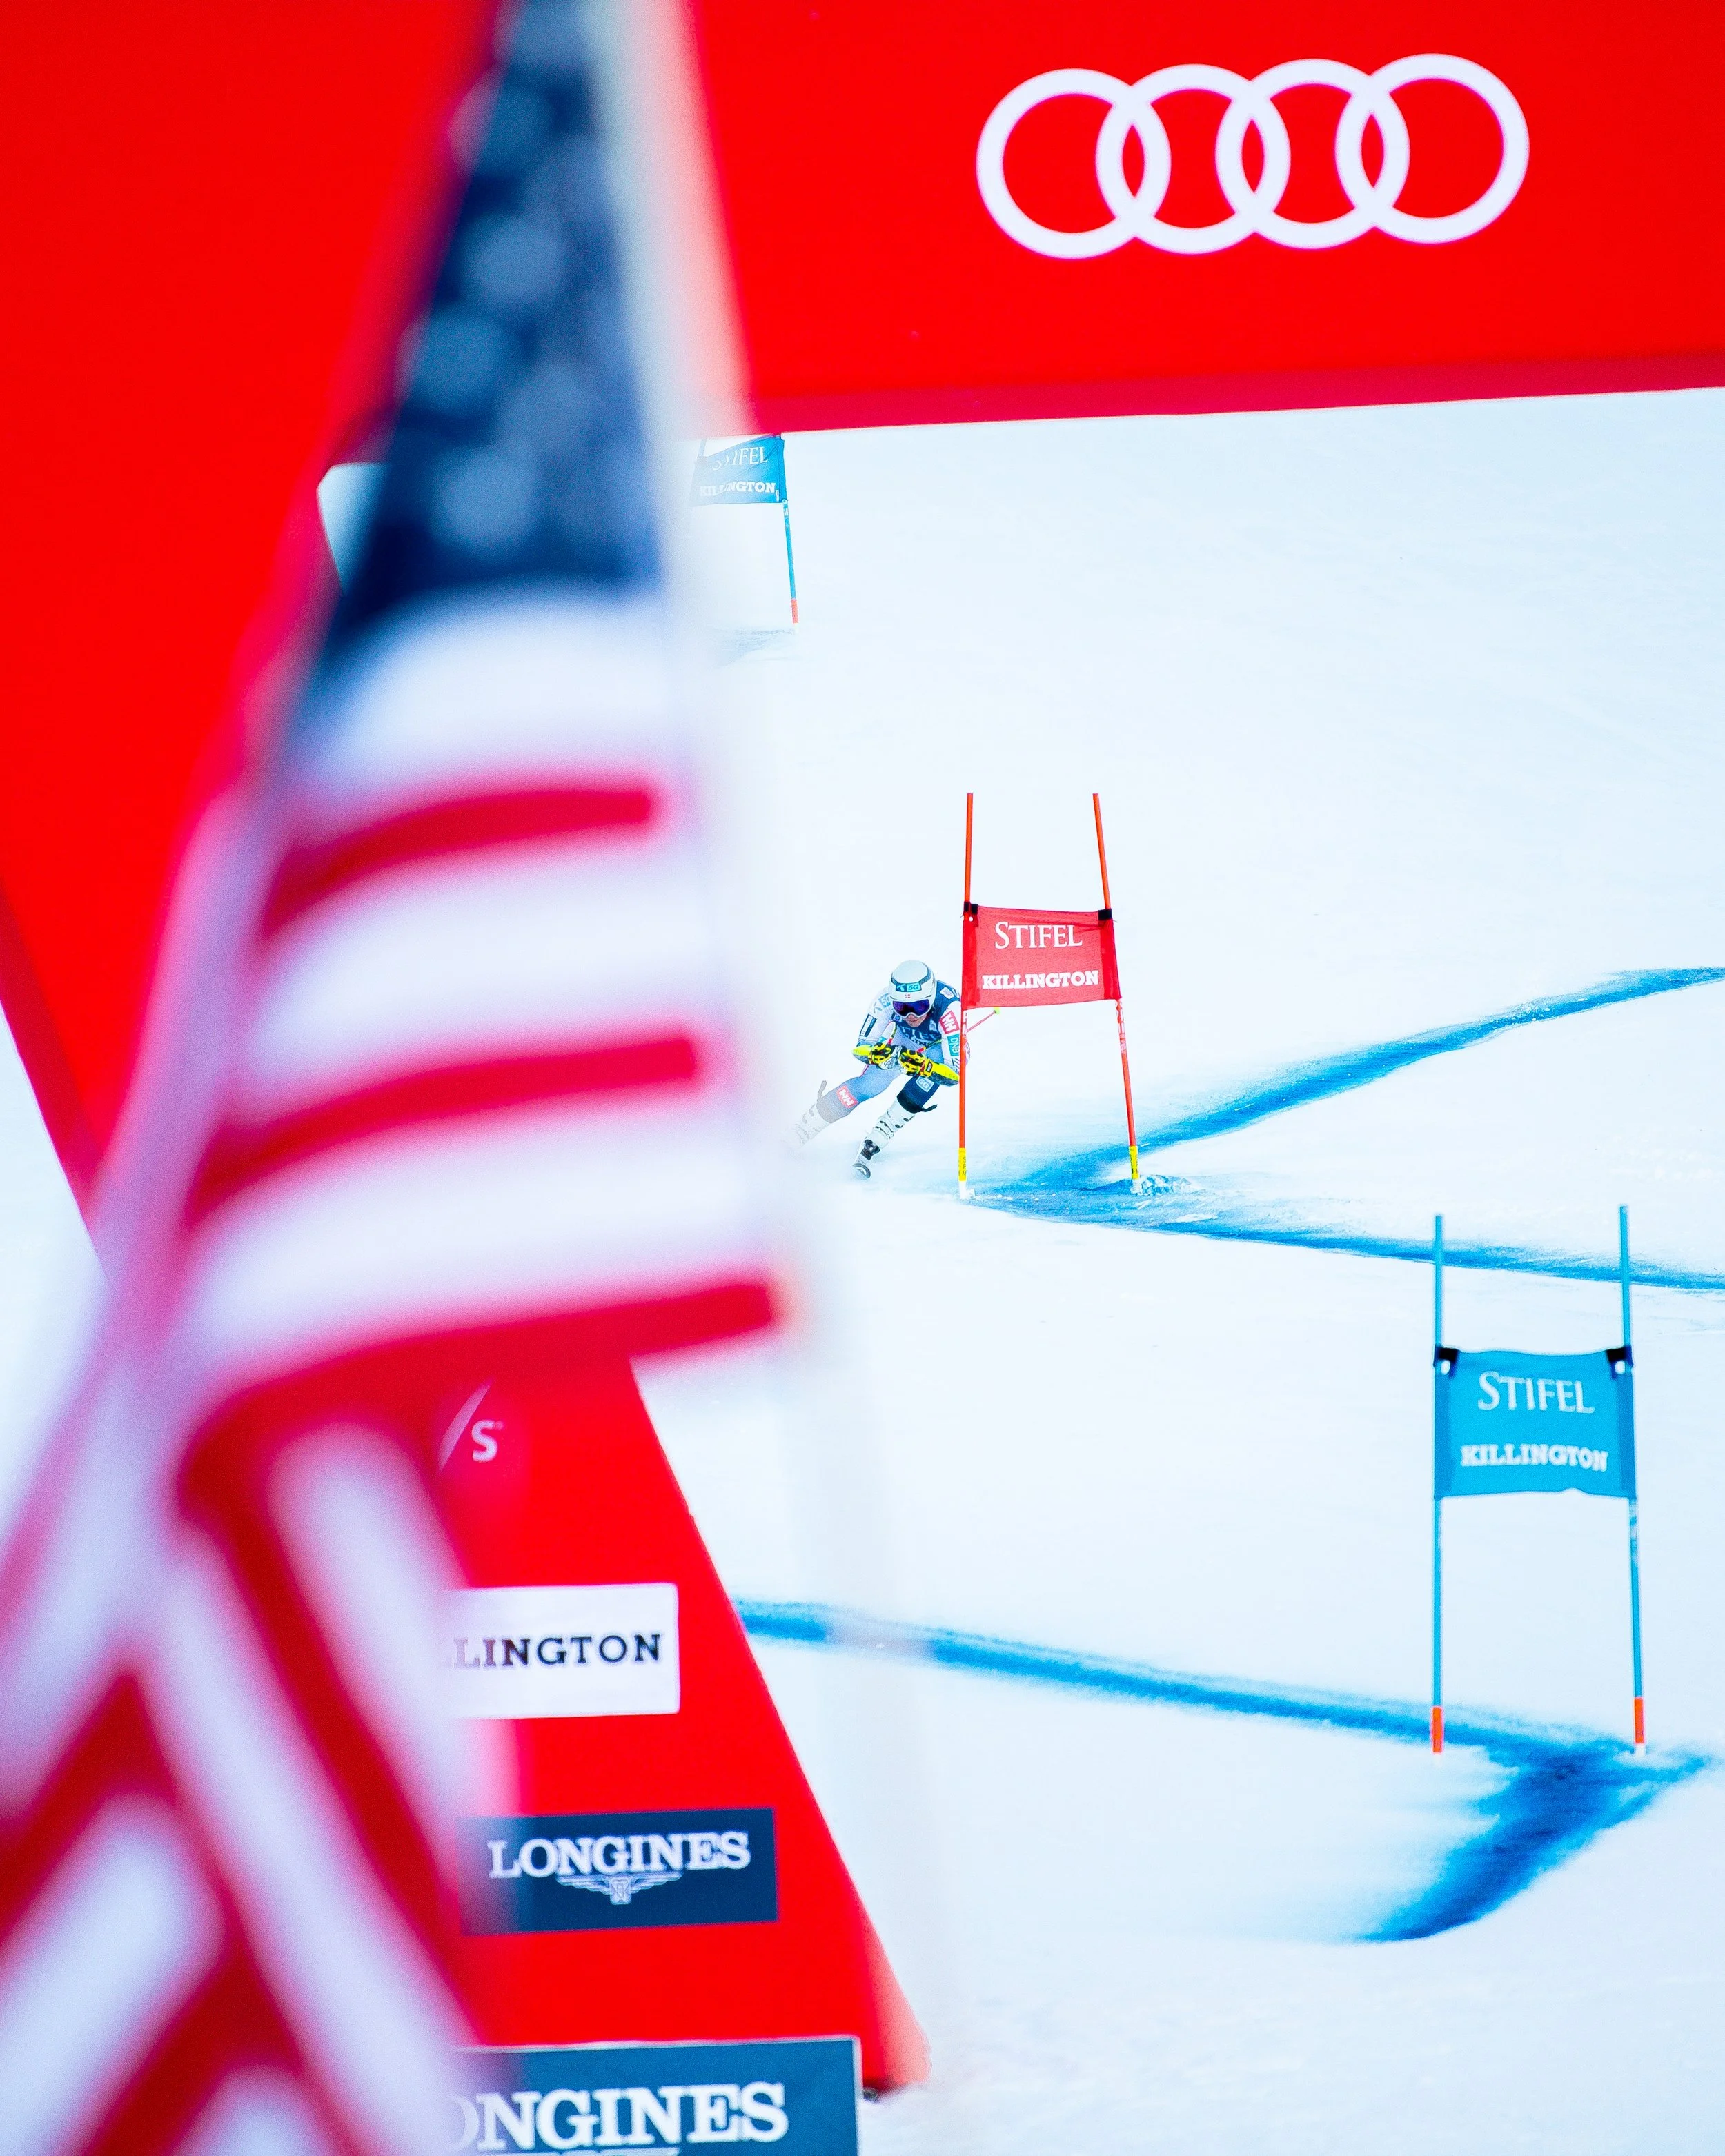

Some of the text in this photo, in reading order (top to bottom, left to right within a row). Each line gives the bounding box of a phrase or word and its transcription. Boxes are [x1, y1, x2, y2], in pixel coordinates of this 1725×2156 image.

[994, 921, 1083, 949] STIFEL
[982, 970, 1098, 989] KILLINGTON
[1477, 1371, 1595, 1414] STIFEL
[1461, 1443, 1608, 1472] KILLINGTON
[446, 1634, 661, 1668] LINGTON
[487, 1830, 751, 1878] LONGINES
